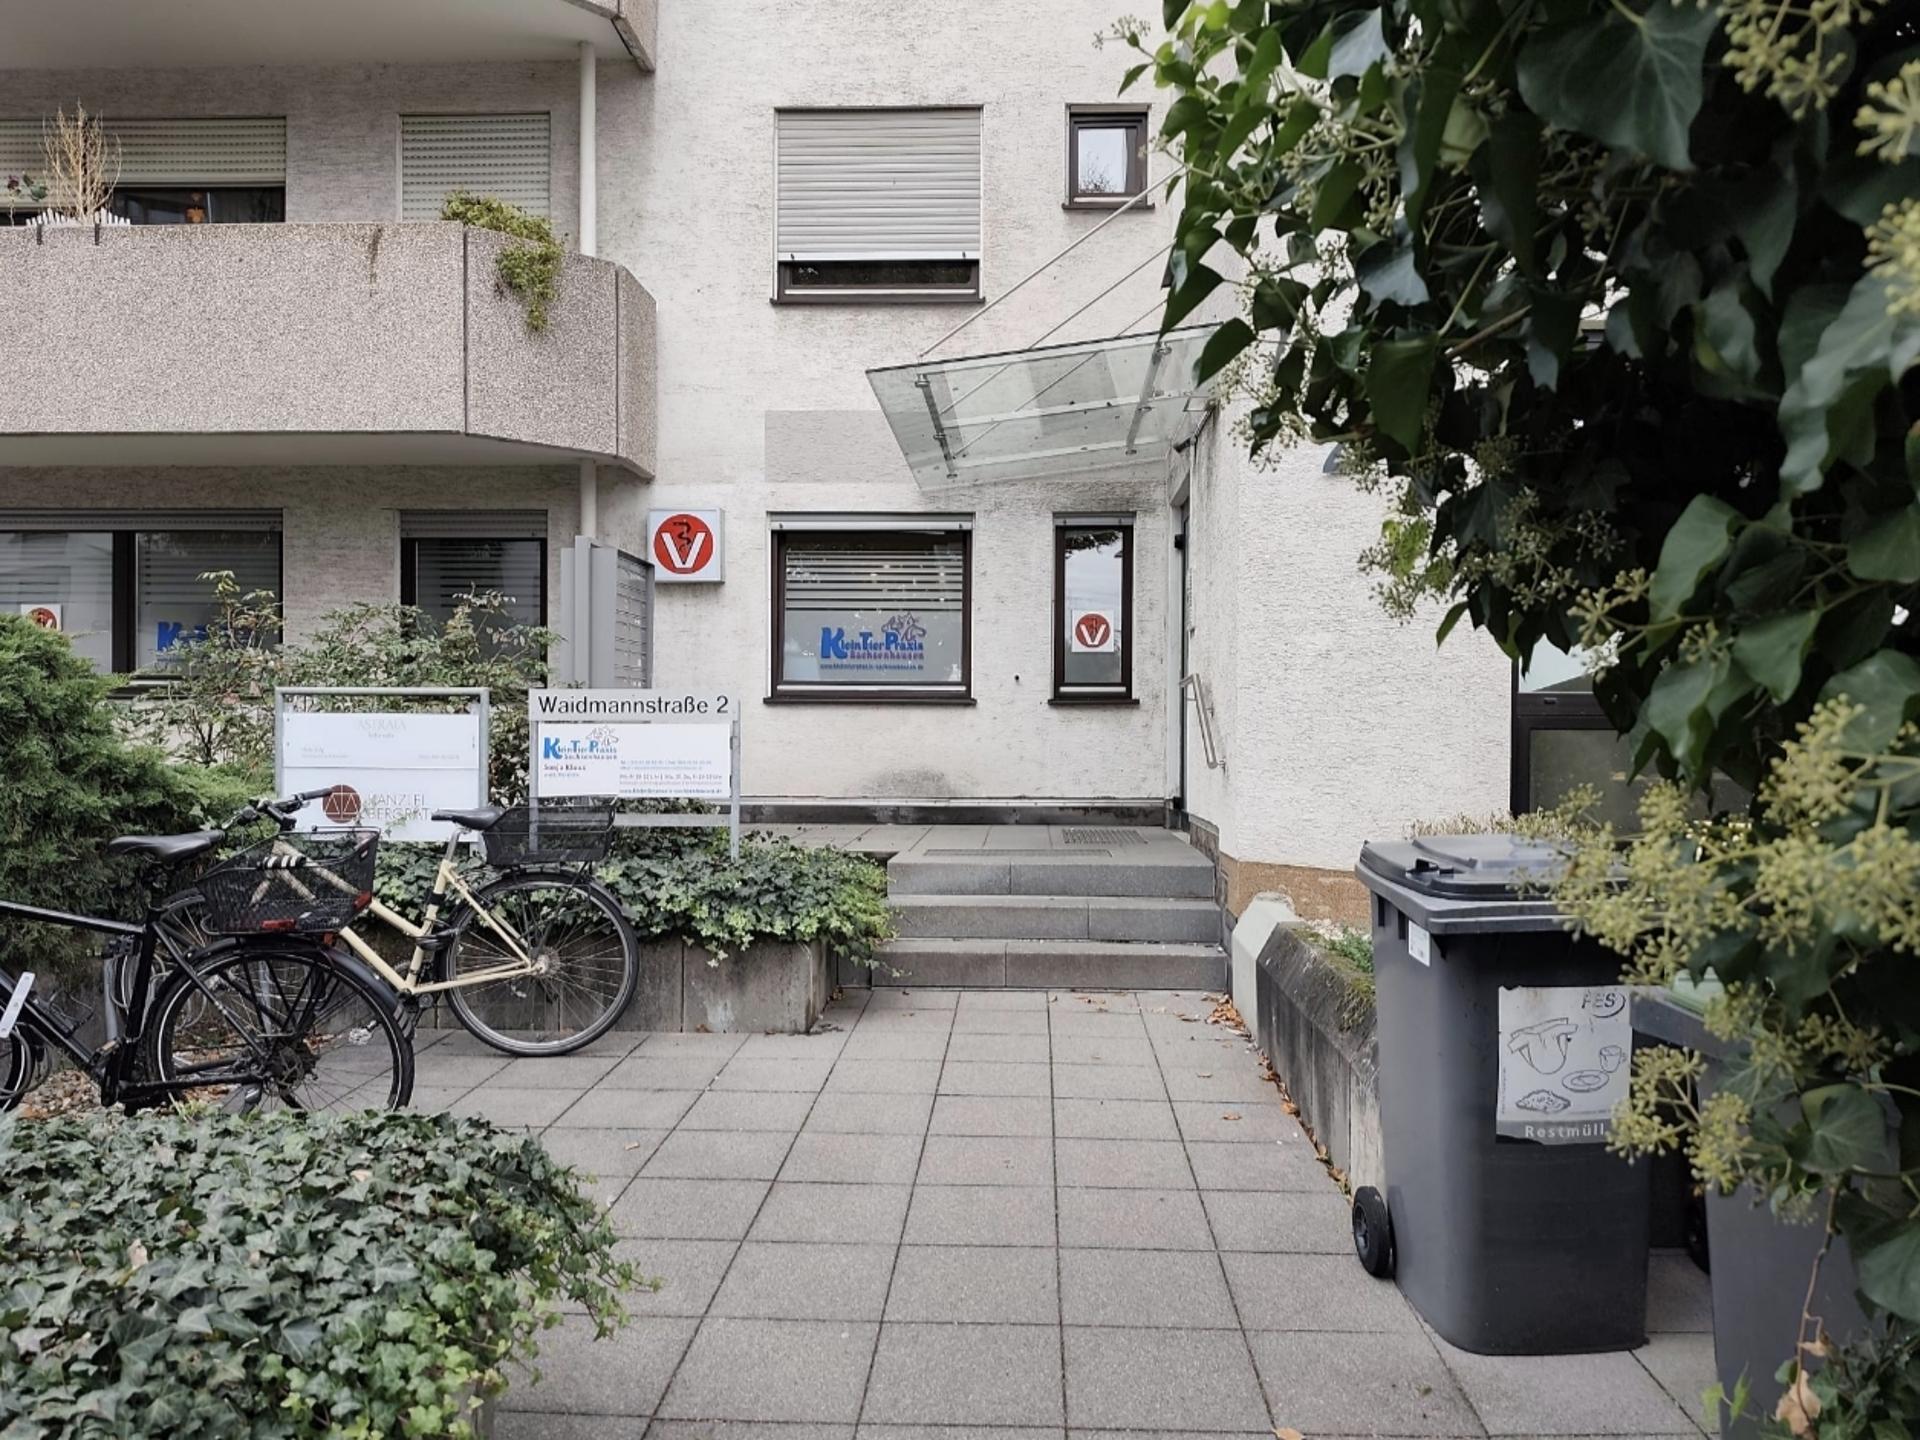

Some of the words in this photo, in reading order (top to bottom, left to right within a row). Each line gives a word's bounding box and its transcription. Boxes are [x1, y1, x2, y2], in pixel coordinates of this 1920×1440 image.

[661, 532, 706, 568] V
[538, 695, 709, 714] Waidmannstraße
[717, 695, 729, 714] 2
[1524, 1122, 1605, 1138] Restmüll
